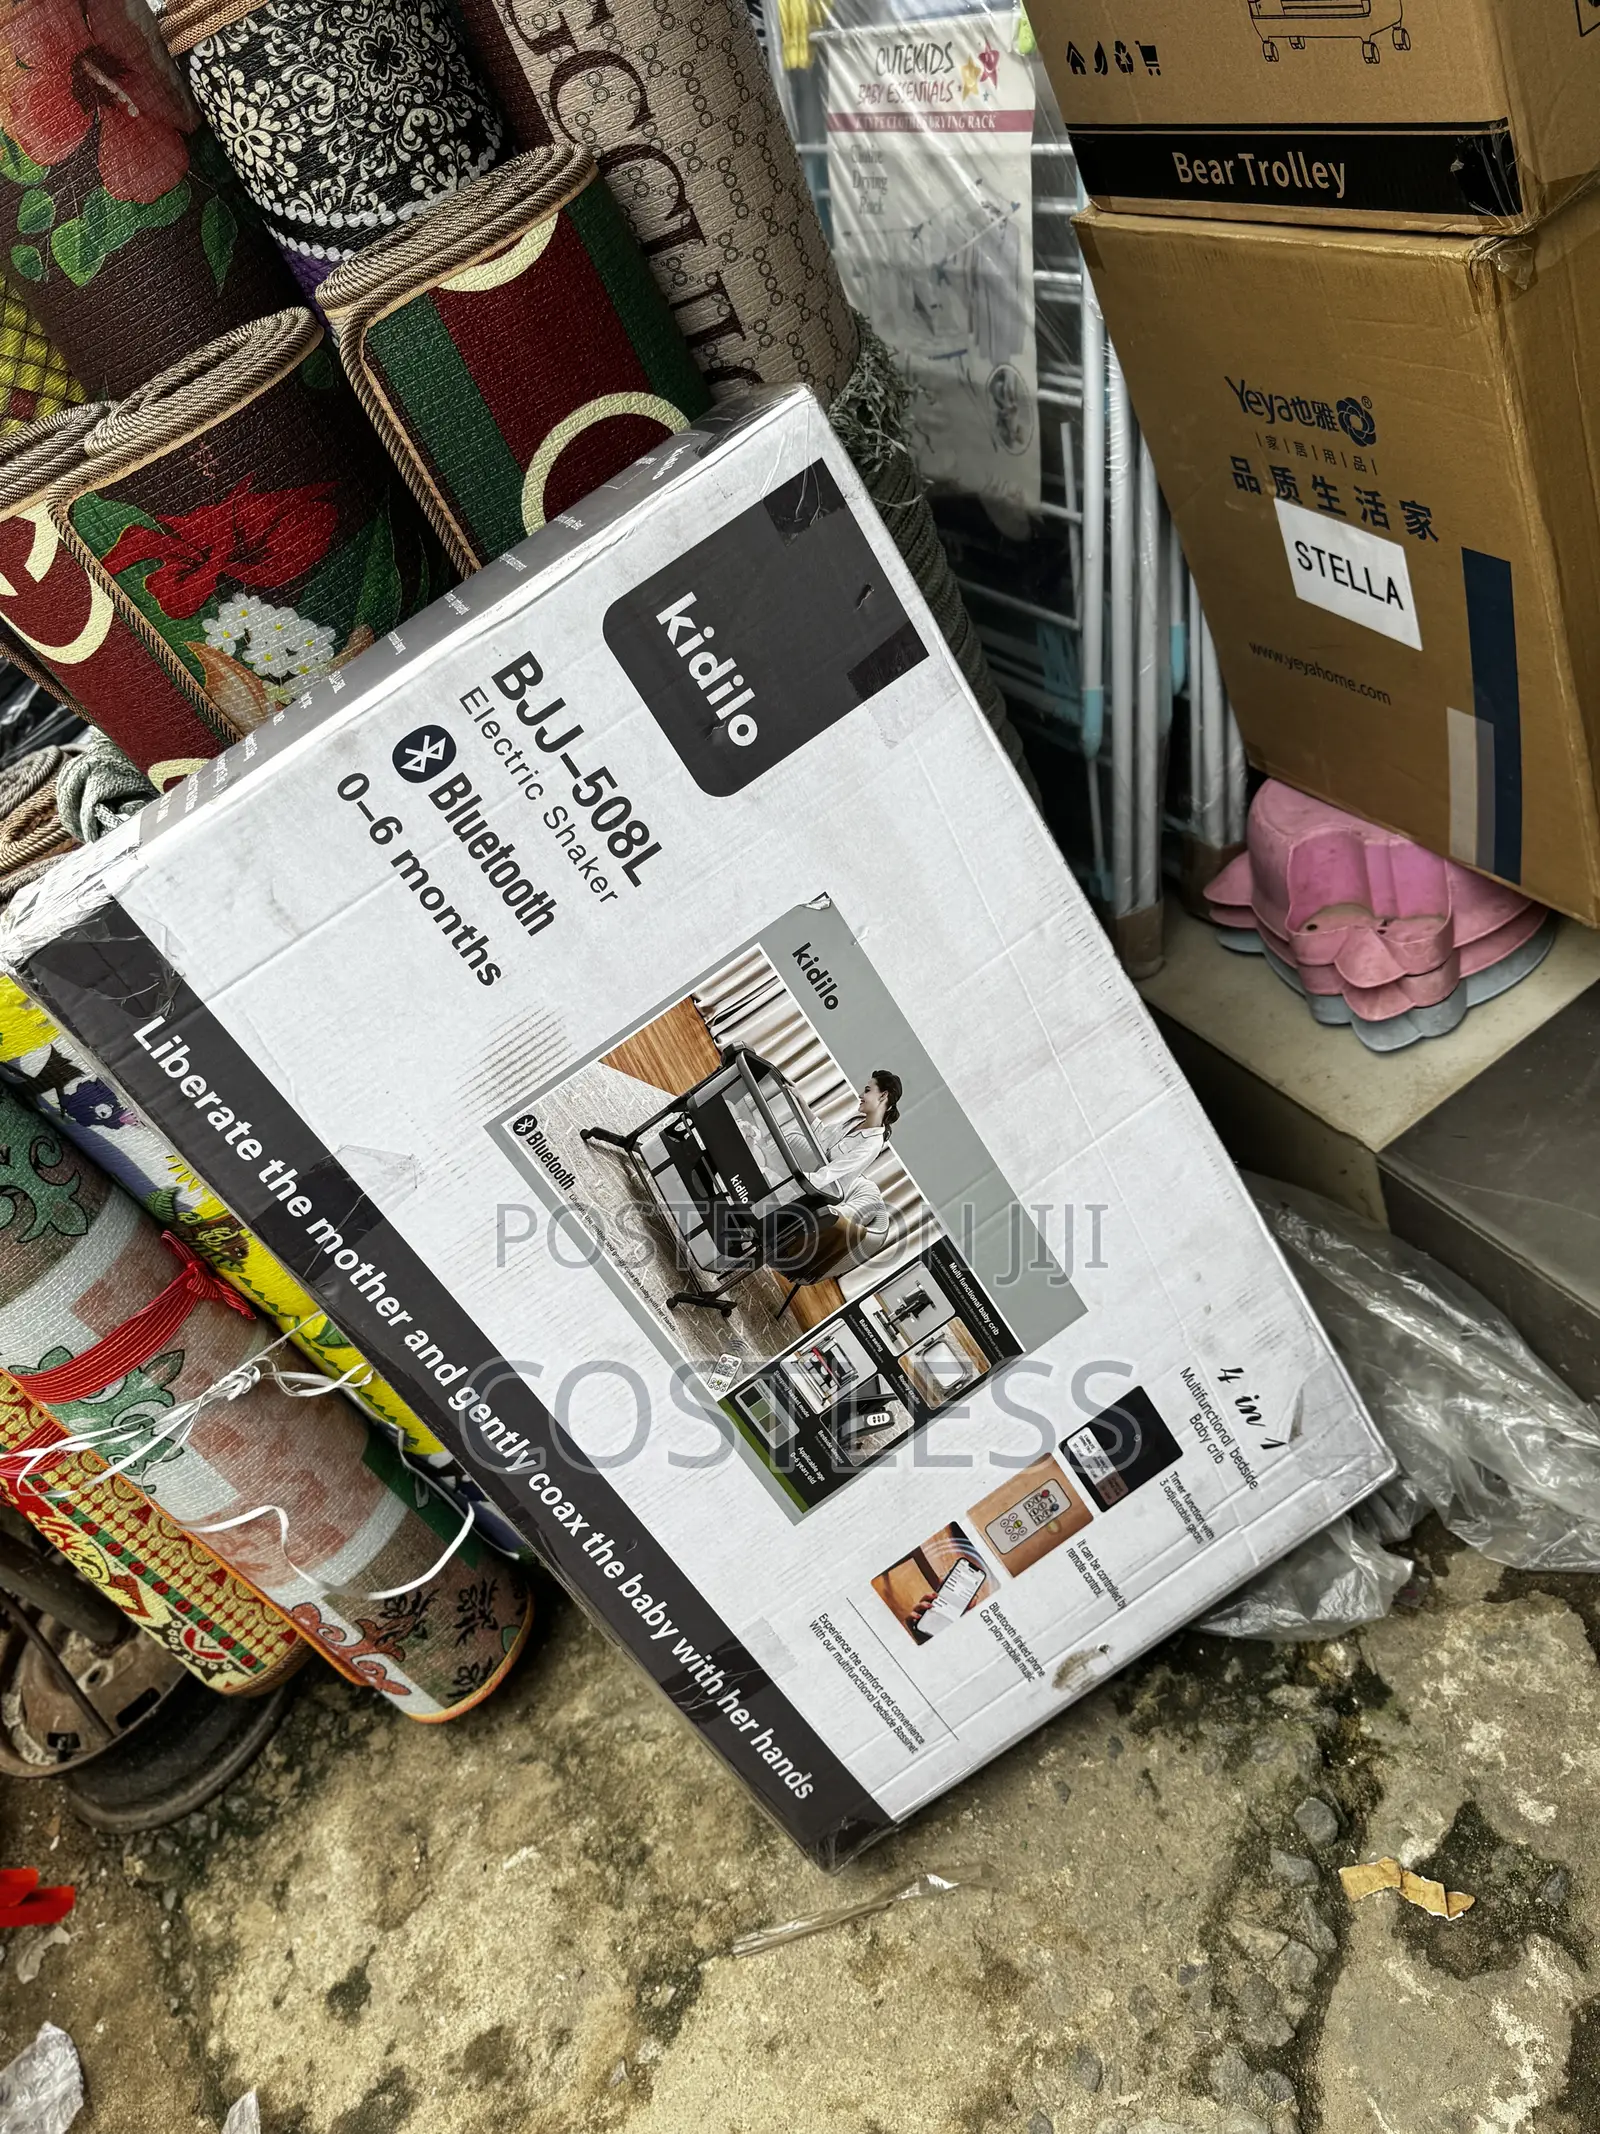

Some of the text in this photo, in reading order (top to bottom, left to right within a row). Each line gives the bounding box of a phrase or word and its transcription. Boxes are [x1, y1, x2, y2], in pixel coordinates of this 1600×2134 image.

[875, 41, 955, 77] CUTEKIDS
[967, 115, 997, 129] RACK
[1172, 151, 1345, 199] Bear Trolley
[1230, 455, 1439, 543] 品质生活家
[1295, 540, 1404, 611] STELLA
[656, 592, 757, 746] kidilo
[1249, 641, 1392, 706] www.yeyahome.com
[459, 686, 618, 902] Electric Shaker
[491, 651, 662, 887] BJJ-508L
[428, 772, 557, 936] Bluetooth
[391, 849, 501, 986] months
[792, 942, 838, 1010] kidilo
[525, 1130, 578, 1192] Bluetooth
[728, 1174, 753, 1206] kidilo
[859, 1318, 875, 1338] Balance
[949, 1262, 1001, 1336] Multi functional baby crib
[133, 1016, 813, 1798] Liberate the mother and gently coax the baby with her hands
[1179, 1366, 1261, 1491] Multifunctional bedside
[1218, 1368, 1244, 1383] 4
[1235, 1395, 1265, 1426] in
[797, 1446, 819, 1472] Applicable
[815, 1471, 826, 1483] age
[1188, 1413, 1226, 1465] Baby crib
[797, 1462, 810, 1476] years
[806, 1474, 817, 1485] old
[1168, 1471, 1216, 1540] Timer function with
[1076, 1539, 1087, 1548] It
[1159, 1478, 1205, 1545] 3 adjustable gears
[1066, 1546, 1088, 1573] remote
[1079, 1545, 1095, 1562] can
[1090, 1558, 1103, 1571] be
[1096, 1568, 1124, 1602] controlled
[979, 1608, 1037, 1683] Can play mobile music
[988, 1601, 1046, 1678] Bluetooth linked phone
[808, 1619, 919, 1755] With our multifunctional bedside Bassinet
[818, 1612, 926, 1745] Experience the comfort and convenience
